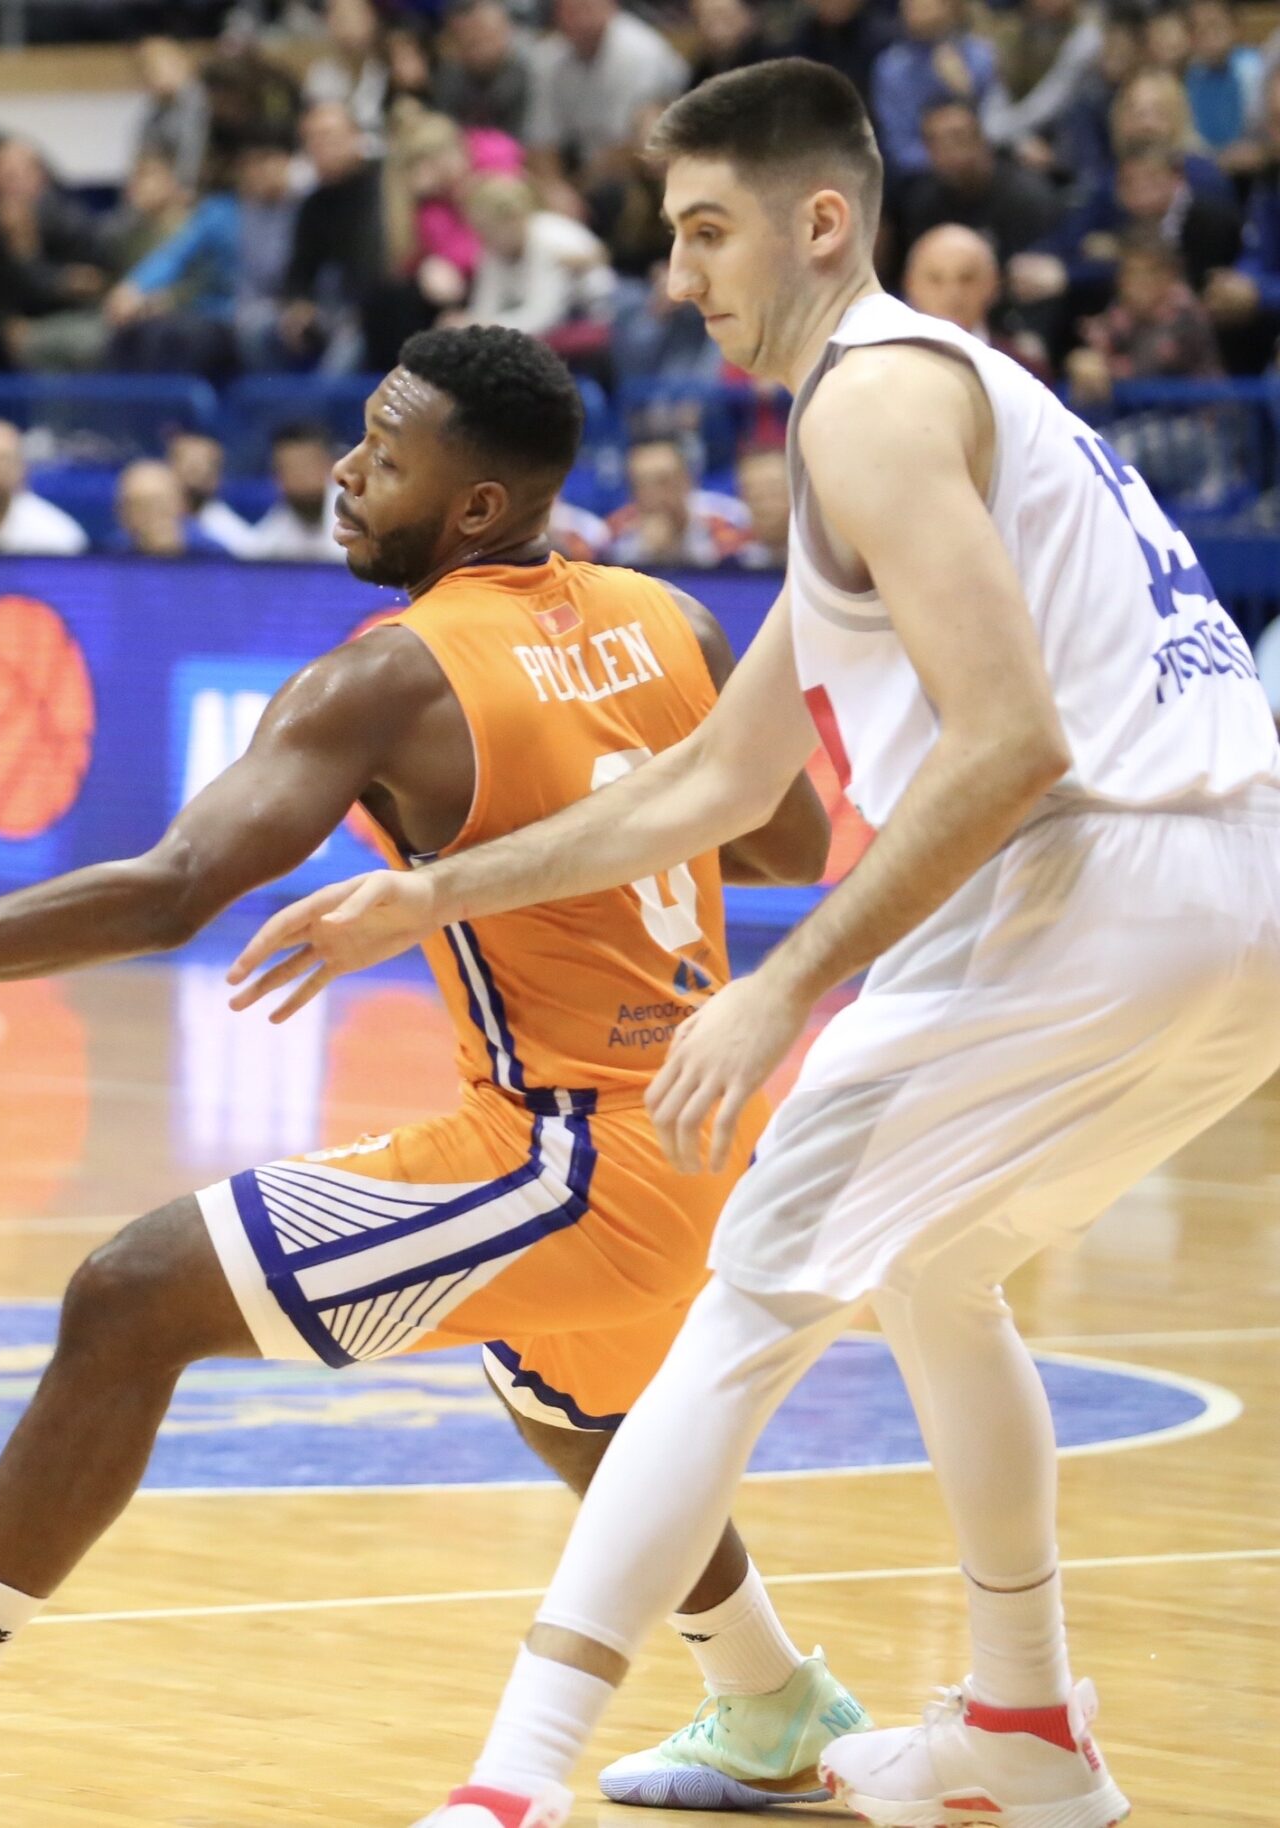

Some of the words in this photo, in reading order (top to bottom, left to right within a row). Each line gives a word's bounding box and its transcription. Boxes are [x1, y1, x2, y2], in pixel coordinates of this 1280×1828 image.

[512, 620, 664, 702] PULLEN
[617, 1001, 699, 1025] Aerodro
[608, 1023, 677, 1051] Airpor
